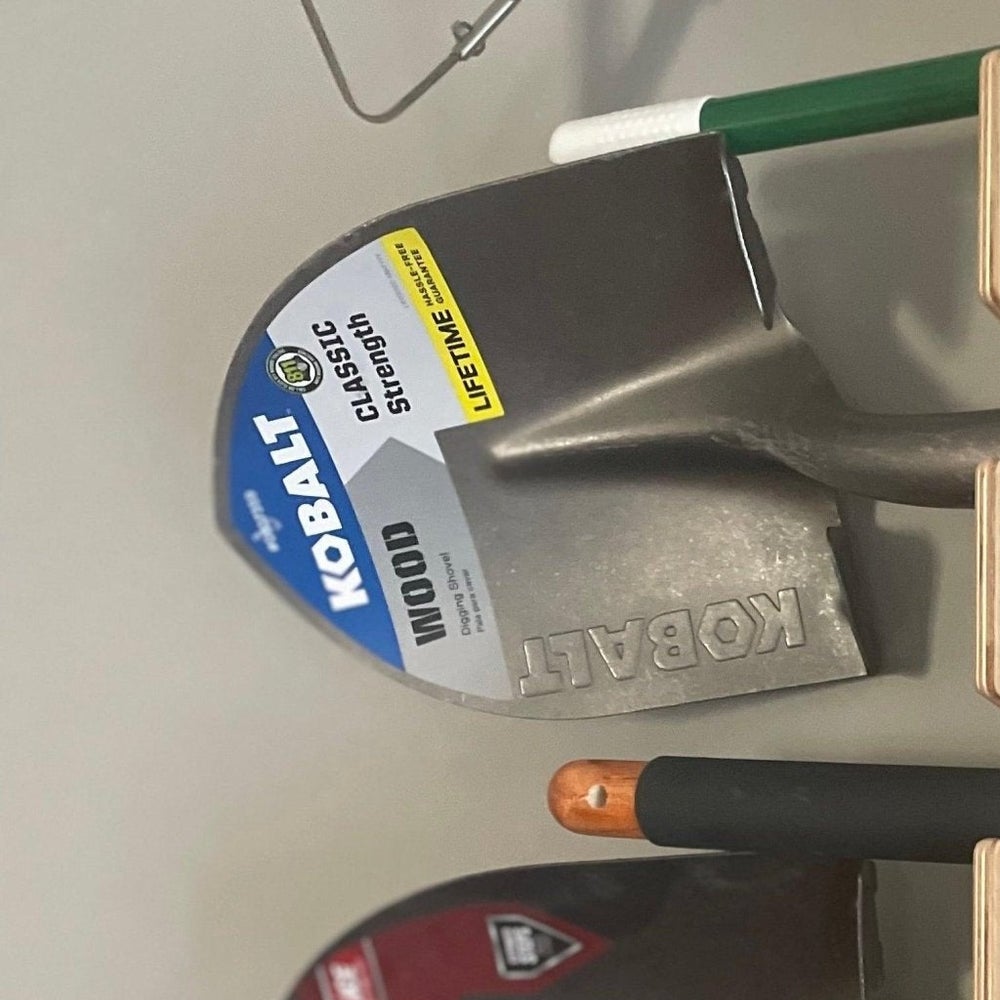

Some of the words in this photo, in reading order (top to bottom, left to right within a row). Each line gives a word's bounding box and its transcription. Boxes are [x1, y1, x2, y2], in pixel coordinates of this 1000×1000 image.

[394, 242, 433, 307] HASSLE-FREE
[410, 248, 446, 305] GUARANTEE
[312, 319, 380, 424] CLASSIC
[347, 312, 412, 416] Strength
[431, 309, 493, 412] LIFETIME
[253, 413, 370, 613] KOBALT
[381, 520, 448, 646] WOOD
[439, 552, 459, 591] Shovel
[454, 593, 472, 636] Digging
[519, 586, 806, 698] KOBALT
